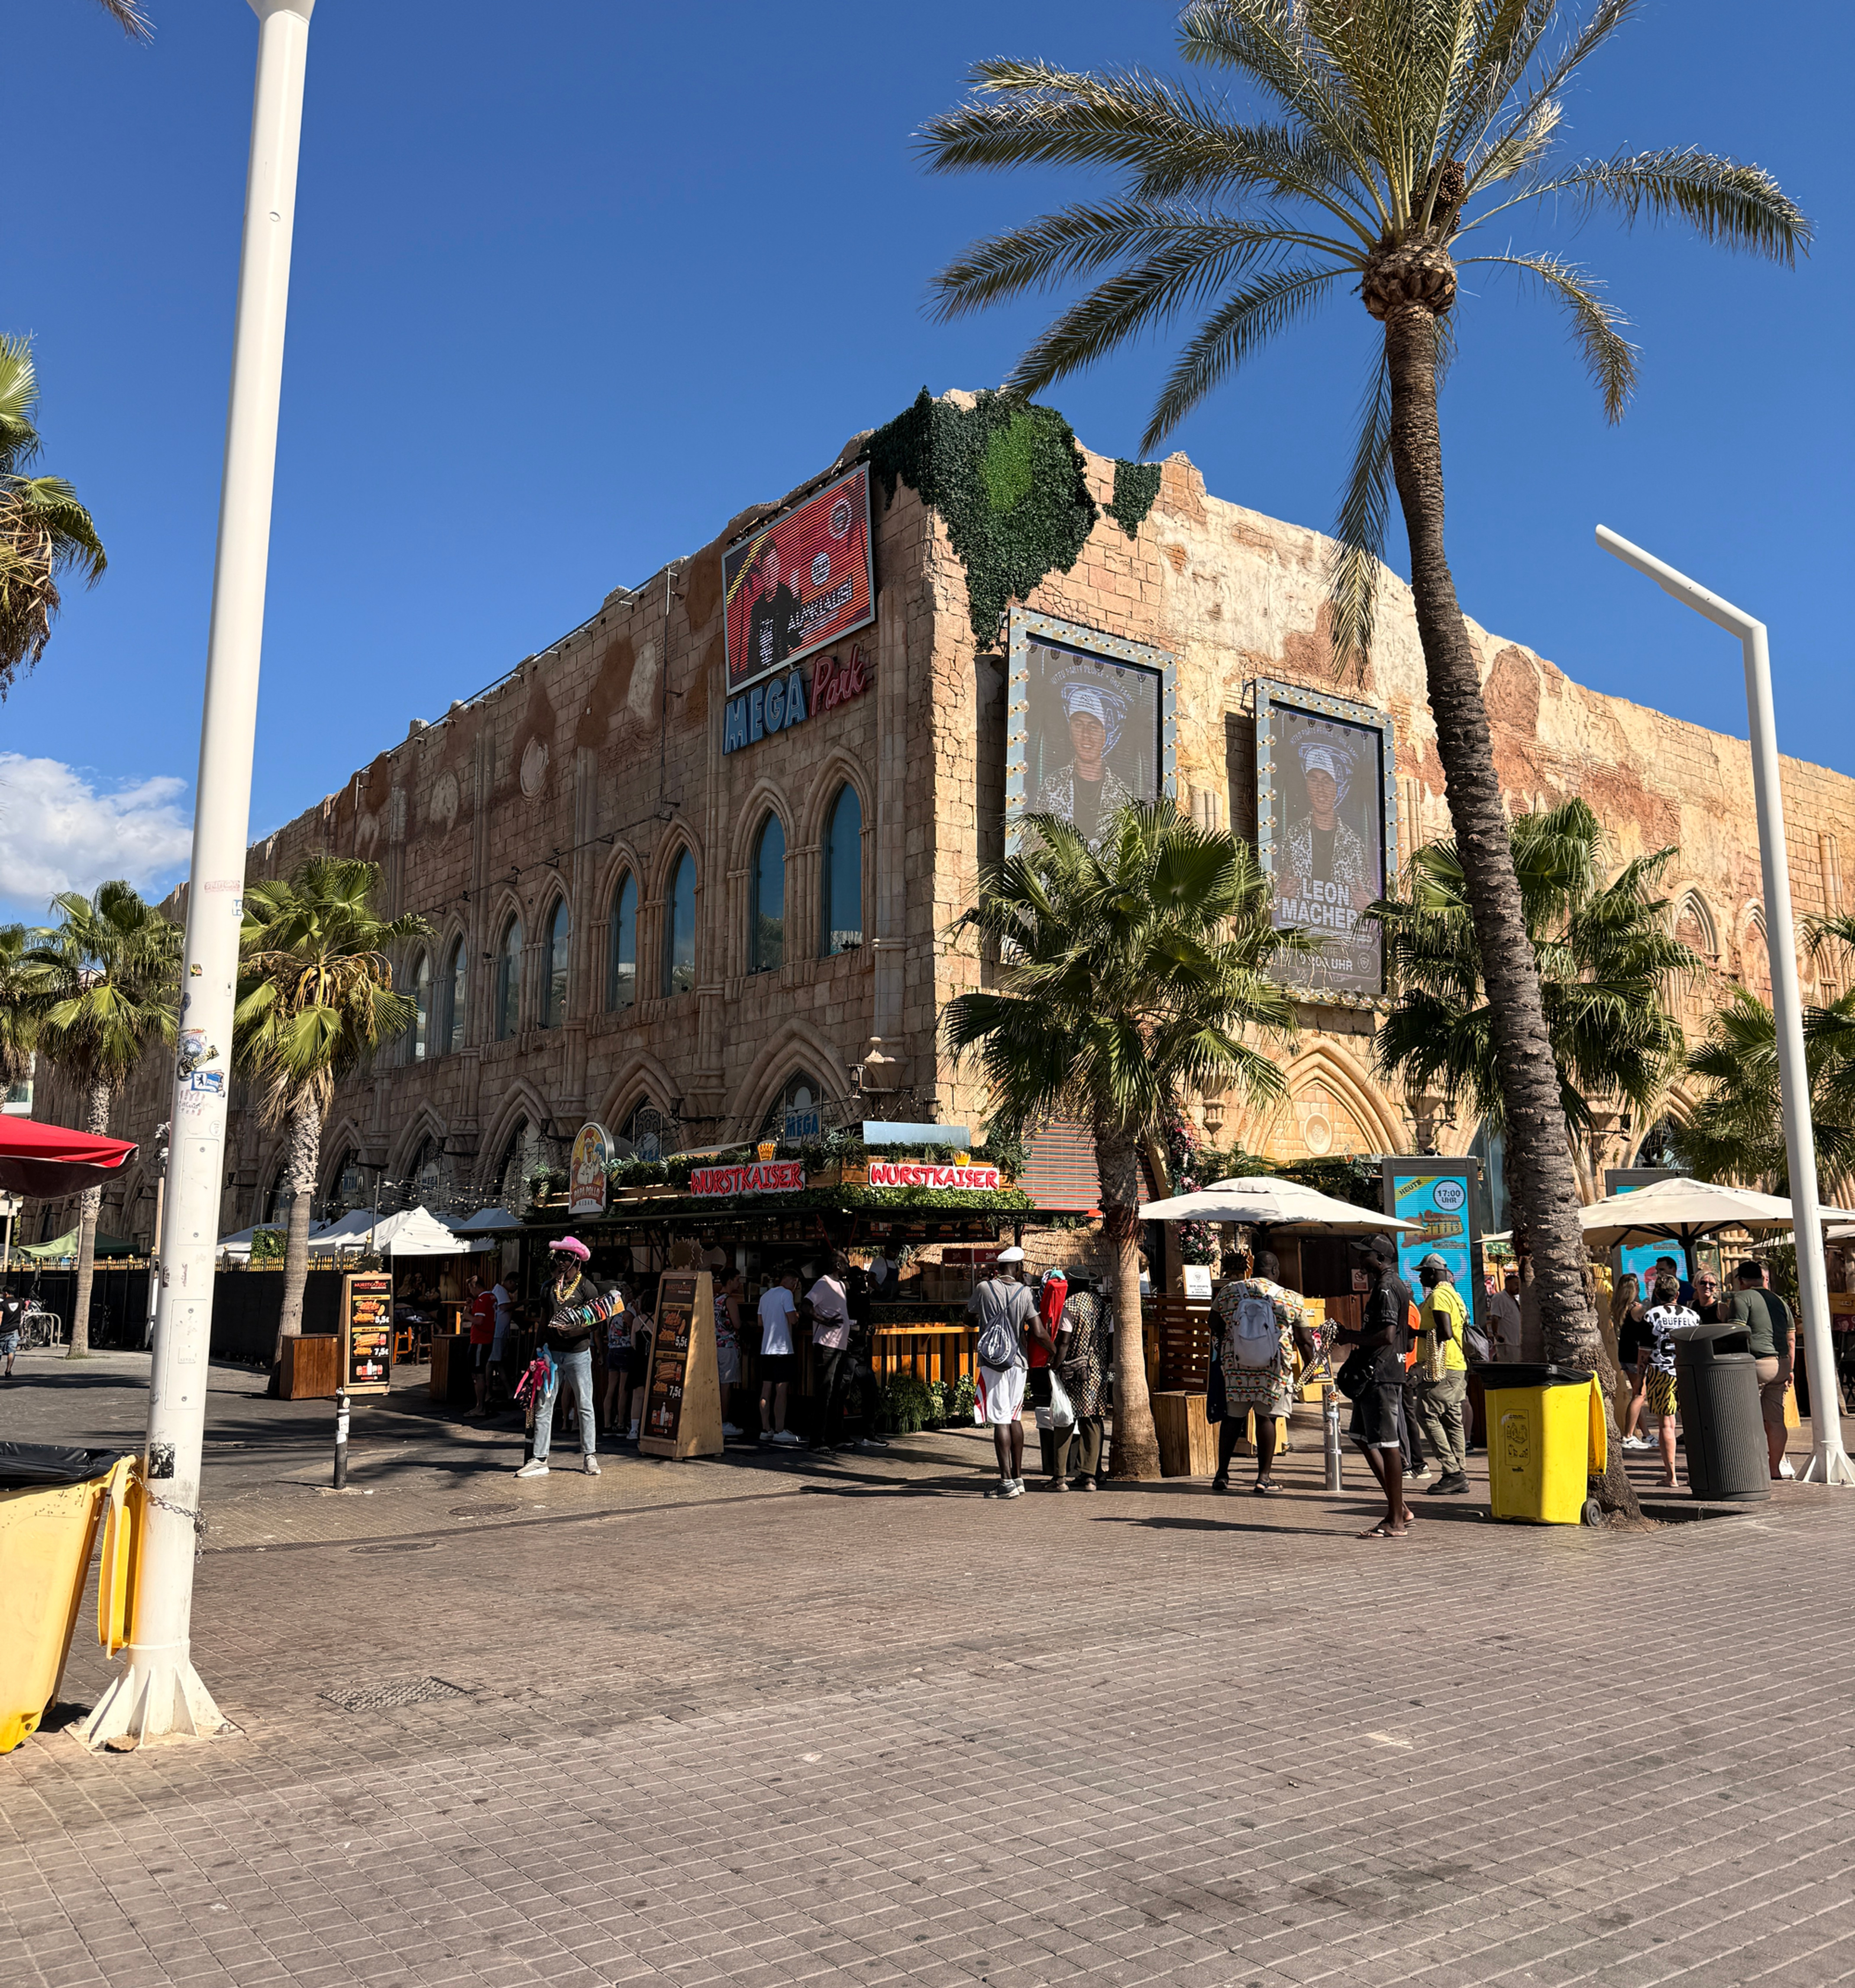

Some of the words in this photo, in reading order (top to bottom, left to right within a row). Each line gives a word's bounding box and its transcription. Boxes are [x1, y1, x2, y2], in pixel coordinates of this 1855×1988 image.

[723, 668, 808, 755] MEGA
[809, 644, 866, 717] Park
[1302, 877, 1350, 907] LEON
[1331, 958, 1353, 971] UHR
[785, 1113, 819, 1137] MEGA
[691, 1163, 803, 1195] WURSTKAISER
[871, 1165, 998, 1189] WURSTKAISER
[574, 1186, 586, 1200] PAPA
[586, 1185, 600, 1198] POLLO
[1399, 1179, 1422, 1195] HEUTE
[375, 1316, 389, 1324] 5,5€
[1662, 1317, 1691, 1326] BÜFFEL
[675, 1336, 688, 1349] 5,5€
[374, 1347, 389, 1357] 7,5€
[669, 1385, 682, 1398] 7,5€
